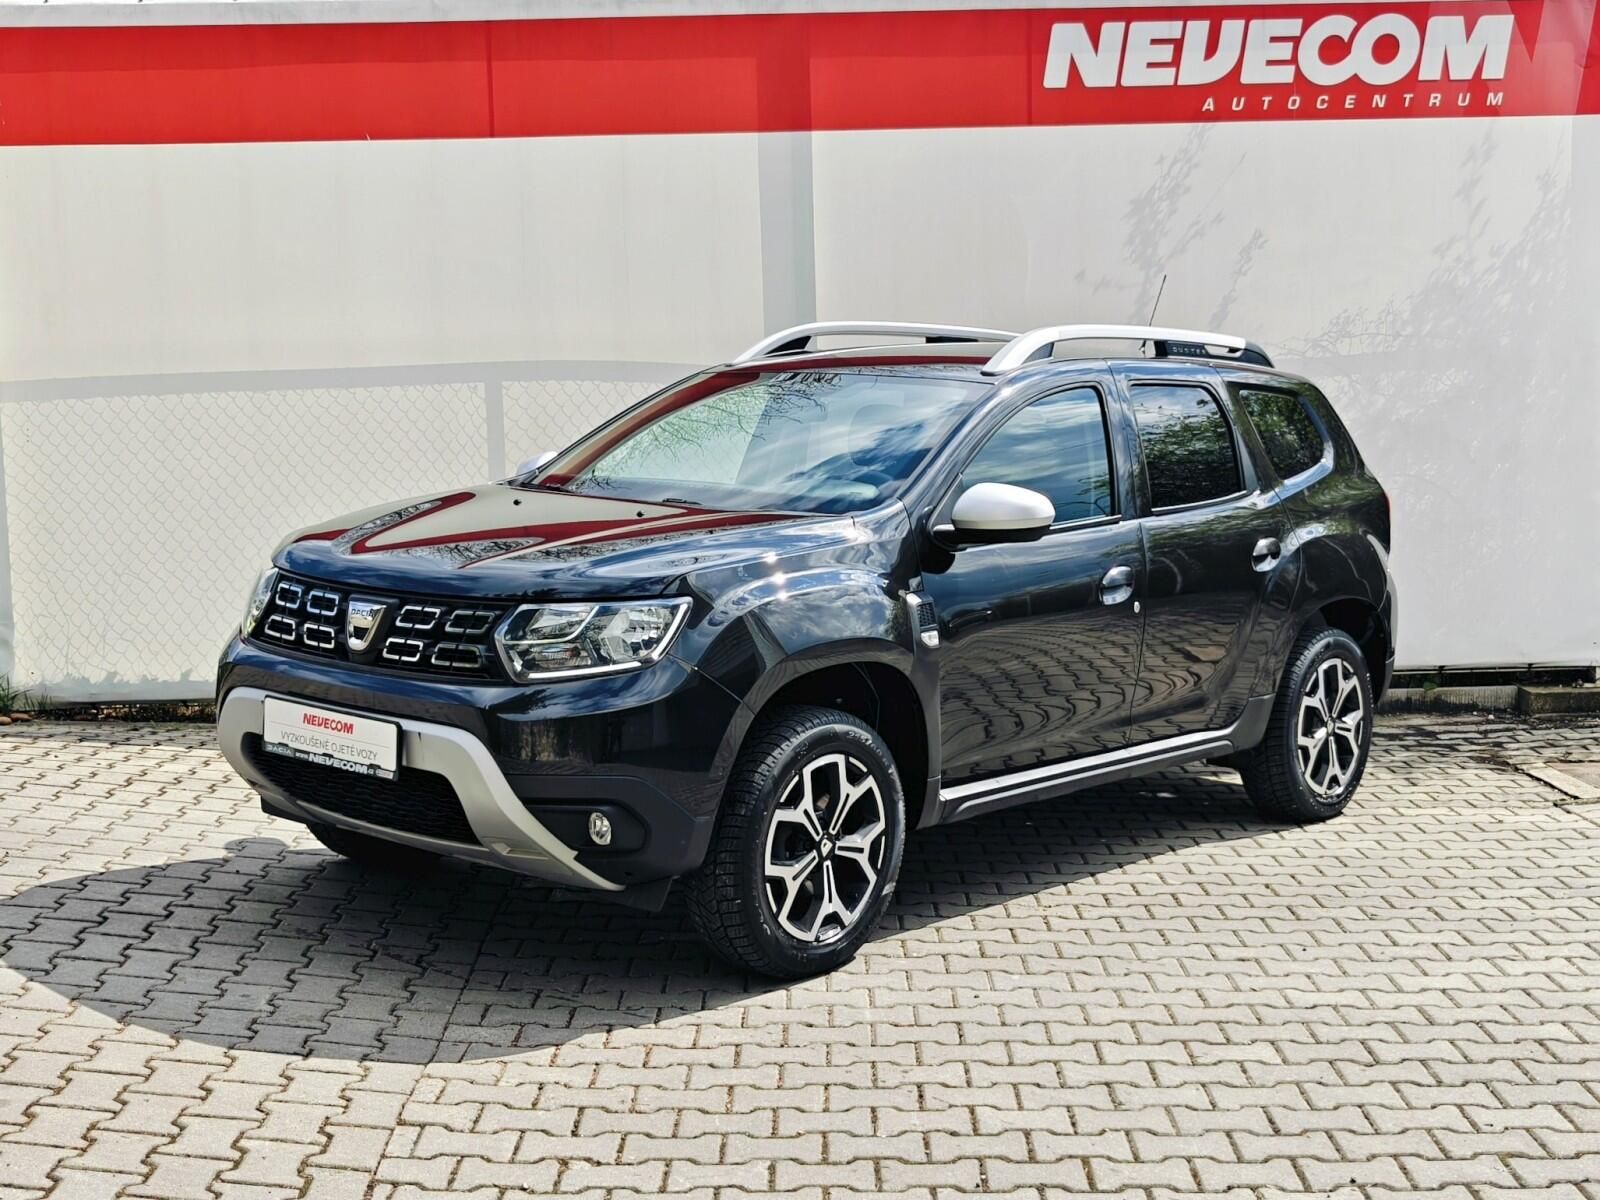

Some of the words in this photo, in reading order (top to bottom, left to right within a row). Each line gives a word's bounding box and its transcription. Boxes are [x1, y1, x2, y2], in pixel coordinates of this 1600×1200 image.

[1043, 13, 1515, 88] NEVECOM
[1202, 92, 1504, 112] AUTOCENTRUM
[351, 608, 374, 617] DACIA
[303, 713, 353, 734] NEVECOM
[356, 747, 378, 760] VOZY
